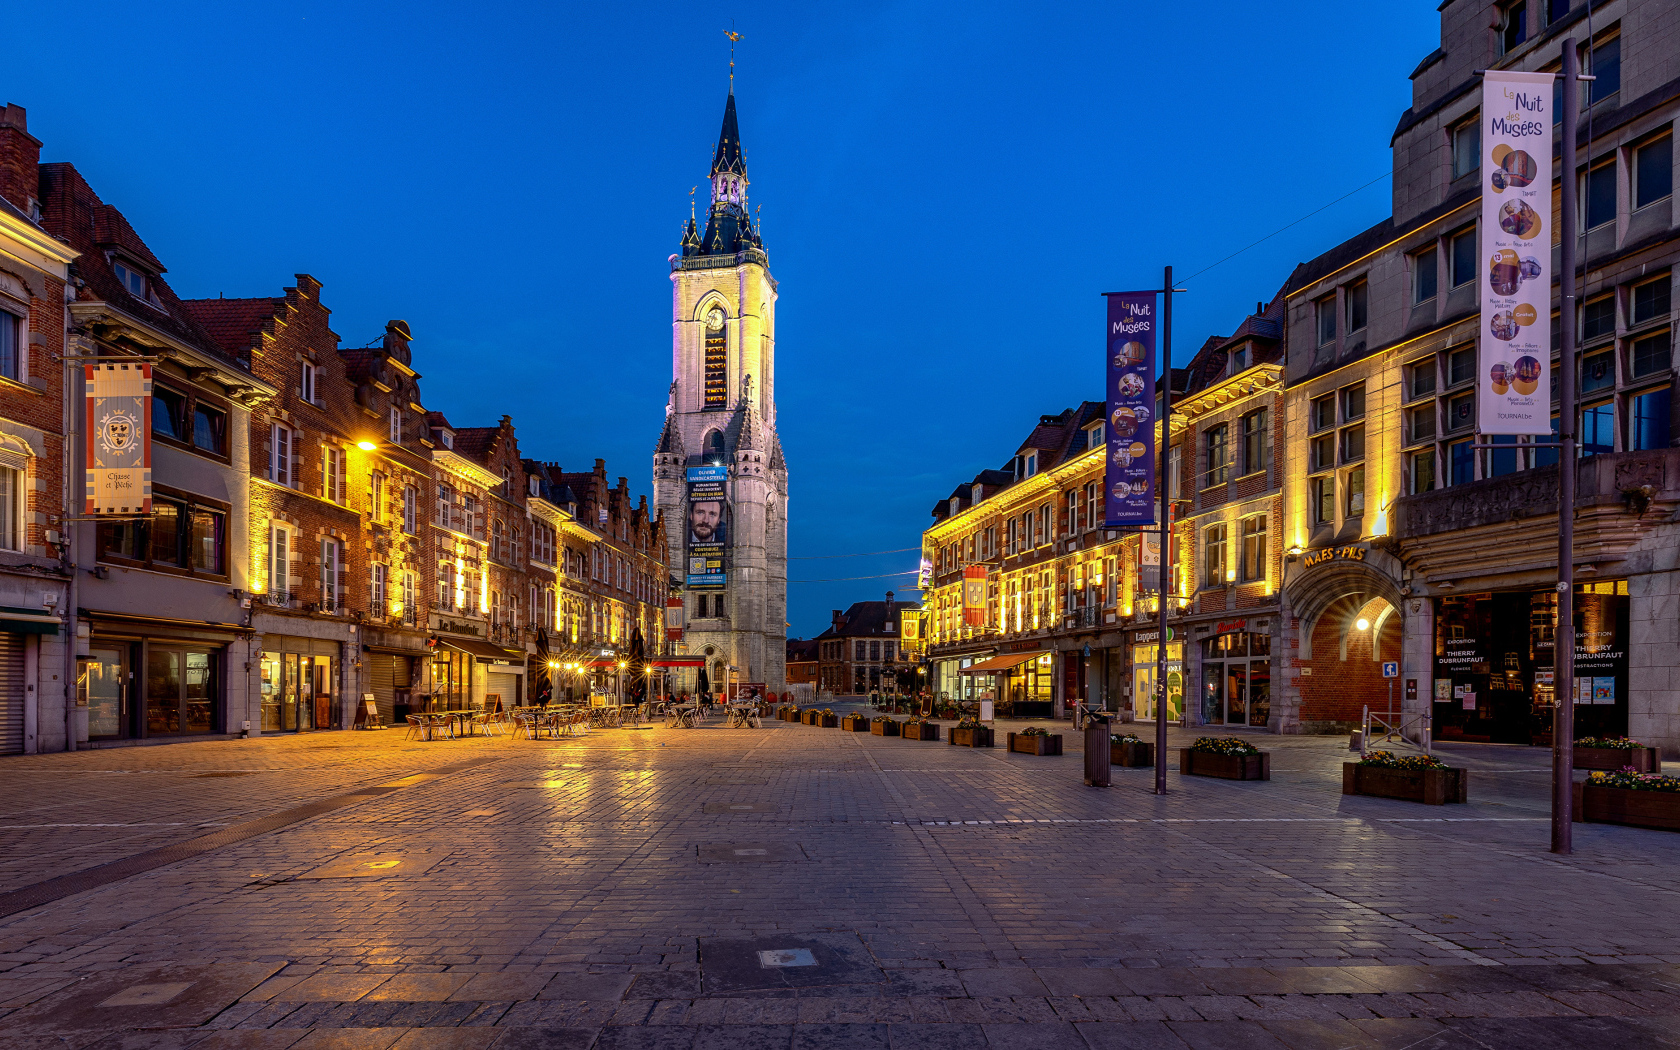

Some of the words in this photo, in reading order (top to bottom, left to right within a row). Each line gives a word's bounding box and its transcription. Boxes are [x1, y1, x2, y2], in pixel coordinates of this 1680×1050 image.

[1504, 86, 1514, 99] La
[1516, 92, 1544, 112] Nuit
[1506, 111, 1520, 122] des
[1492, 118, 1542, 137] Musées
[1122, 301, 1129, 309] La
[1130, 303, 1150, 316] Nuit
[1113, 321, 1150, 334] Musées
[108, 472, 130, 481] Chasse
[1304, 547, 1334, 568] MAES
[1342, 547, 1366, 560] PILS
[450, 621, 479, 635] Boudoir
[1216, 619, 1246, 634] Barista
[1135, 632, 1159, 642] Lapperr
